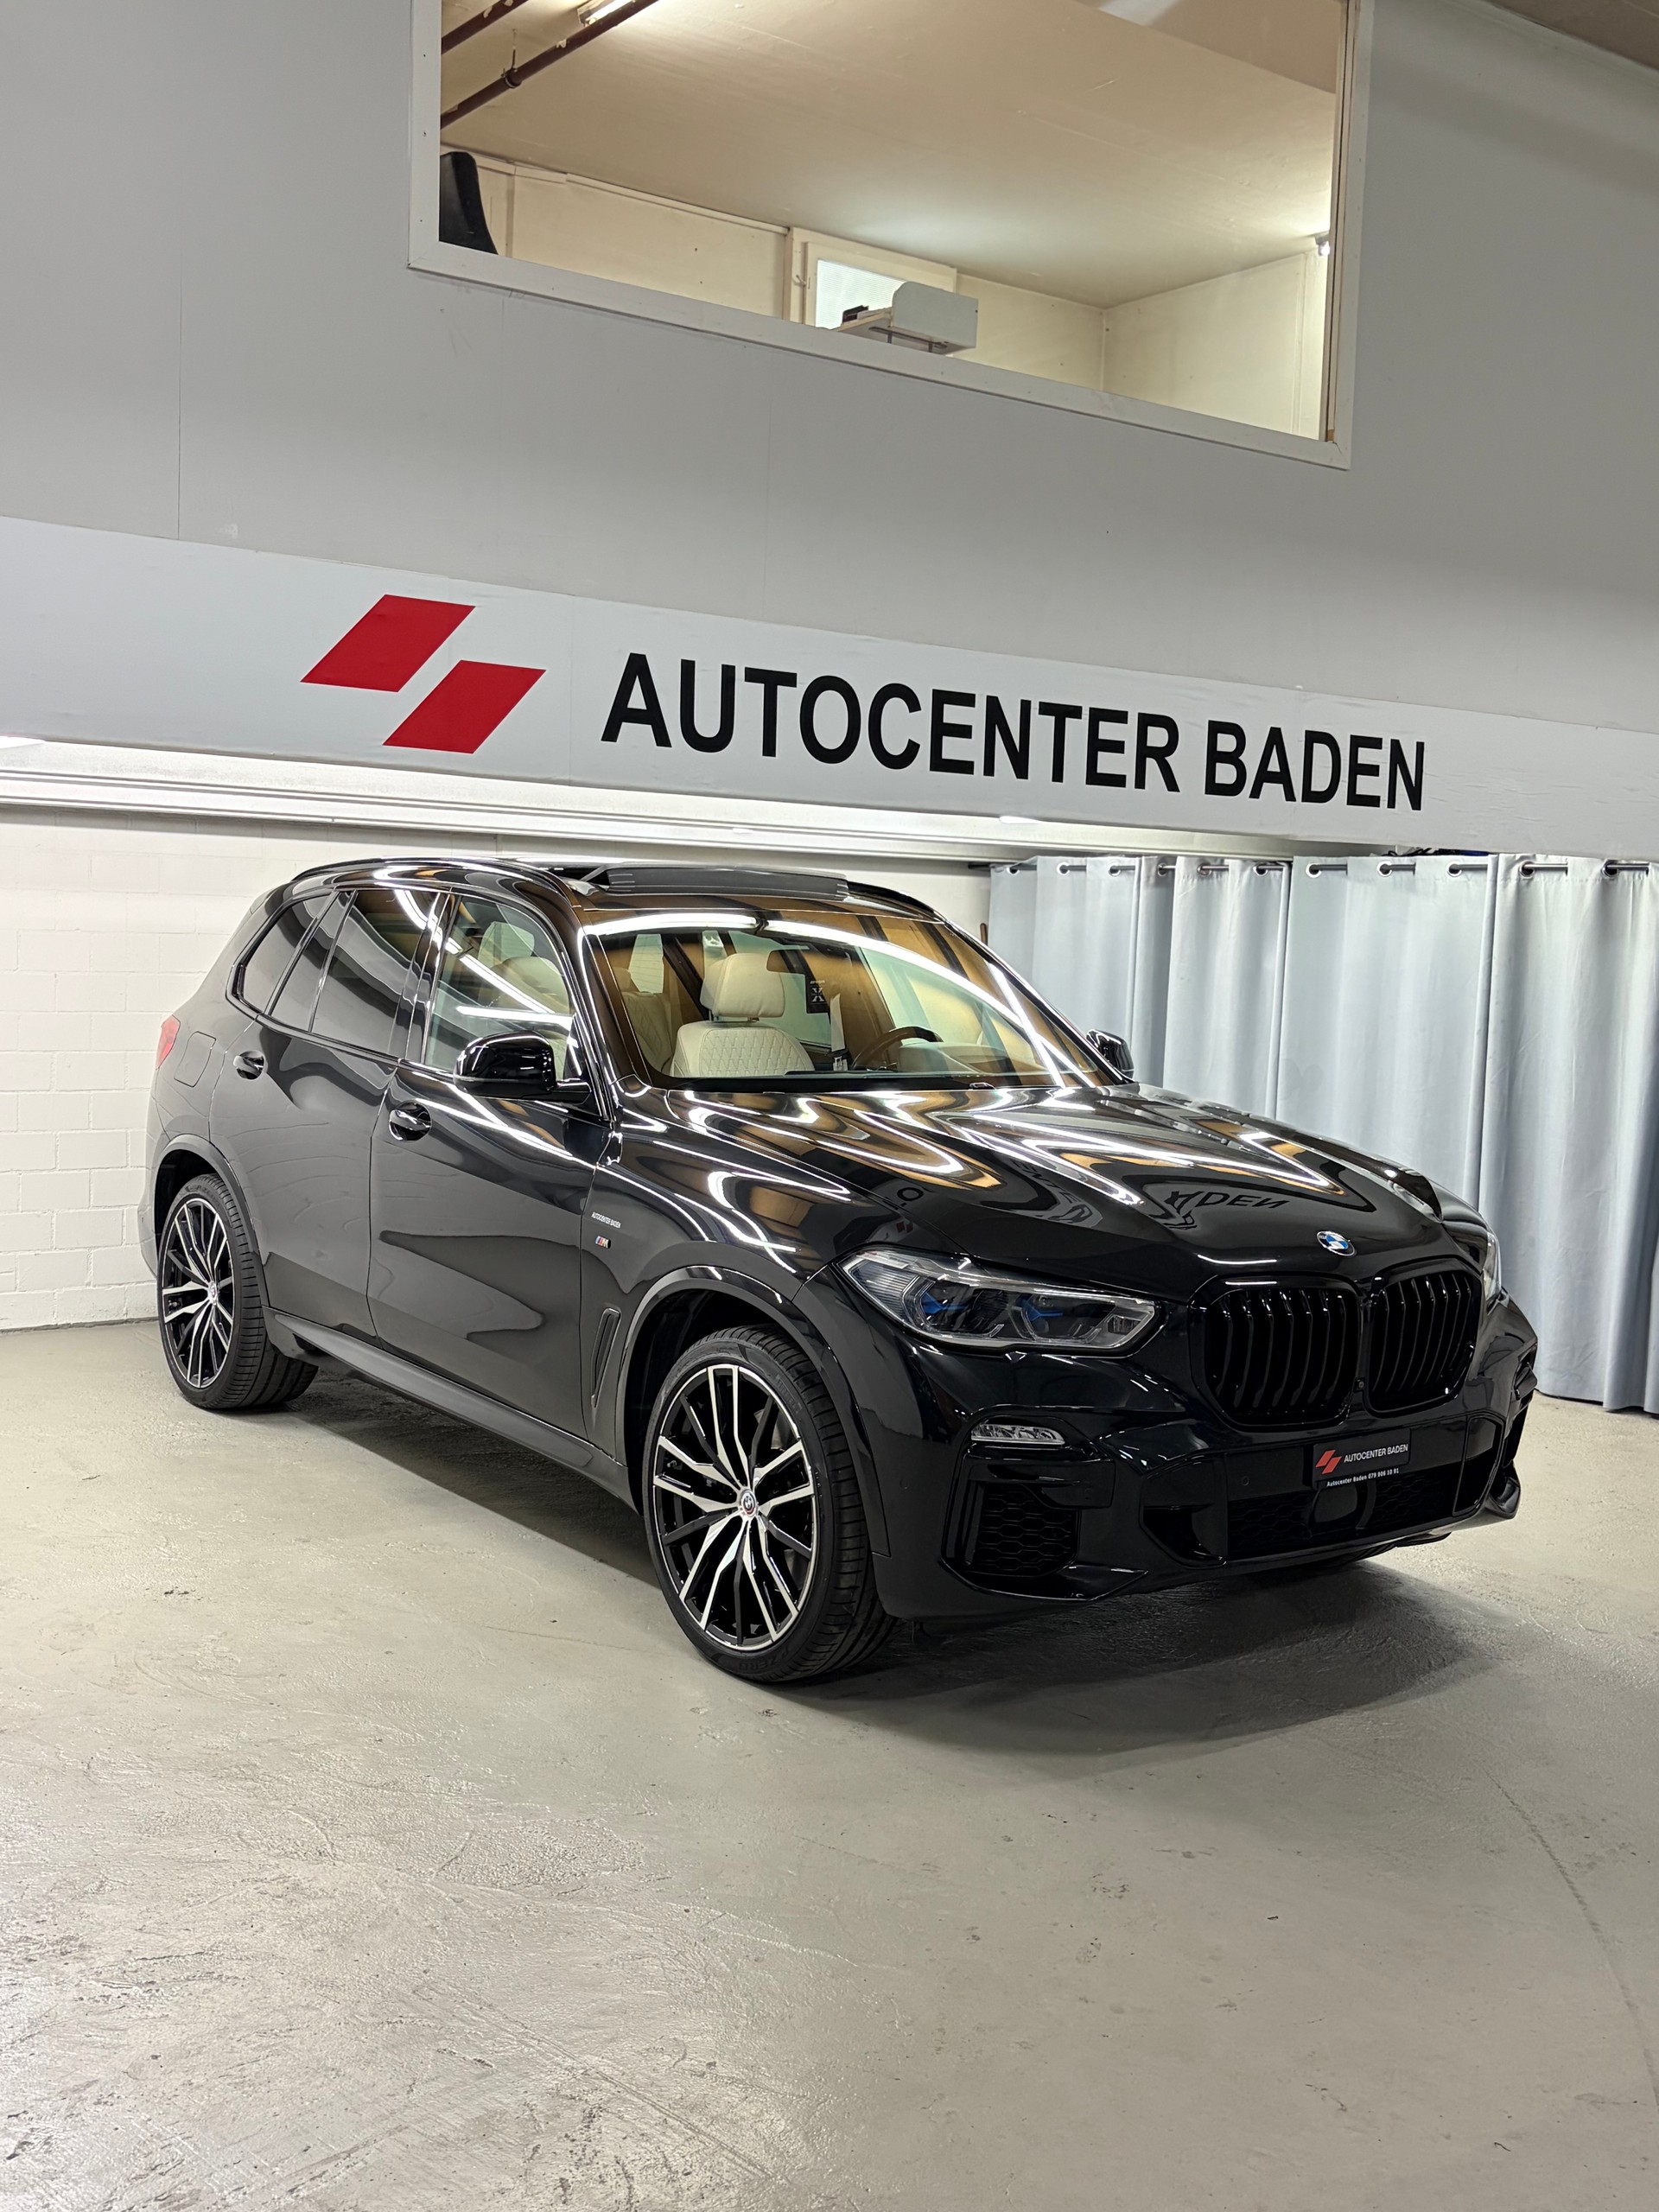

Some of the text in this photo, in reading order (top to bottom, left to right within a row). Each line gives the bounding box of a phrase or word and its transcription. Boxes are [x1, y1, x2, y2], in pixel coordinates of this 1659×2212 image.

[601, 653, 1424, 810] AUTOCENTER BADEN
[1344, 1443, 1408, 1463] AUTOCENTER BADEN
[1326, 1478, 1352, 1487] Autocenter
